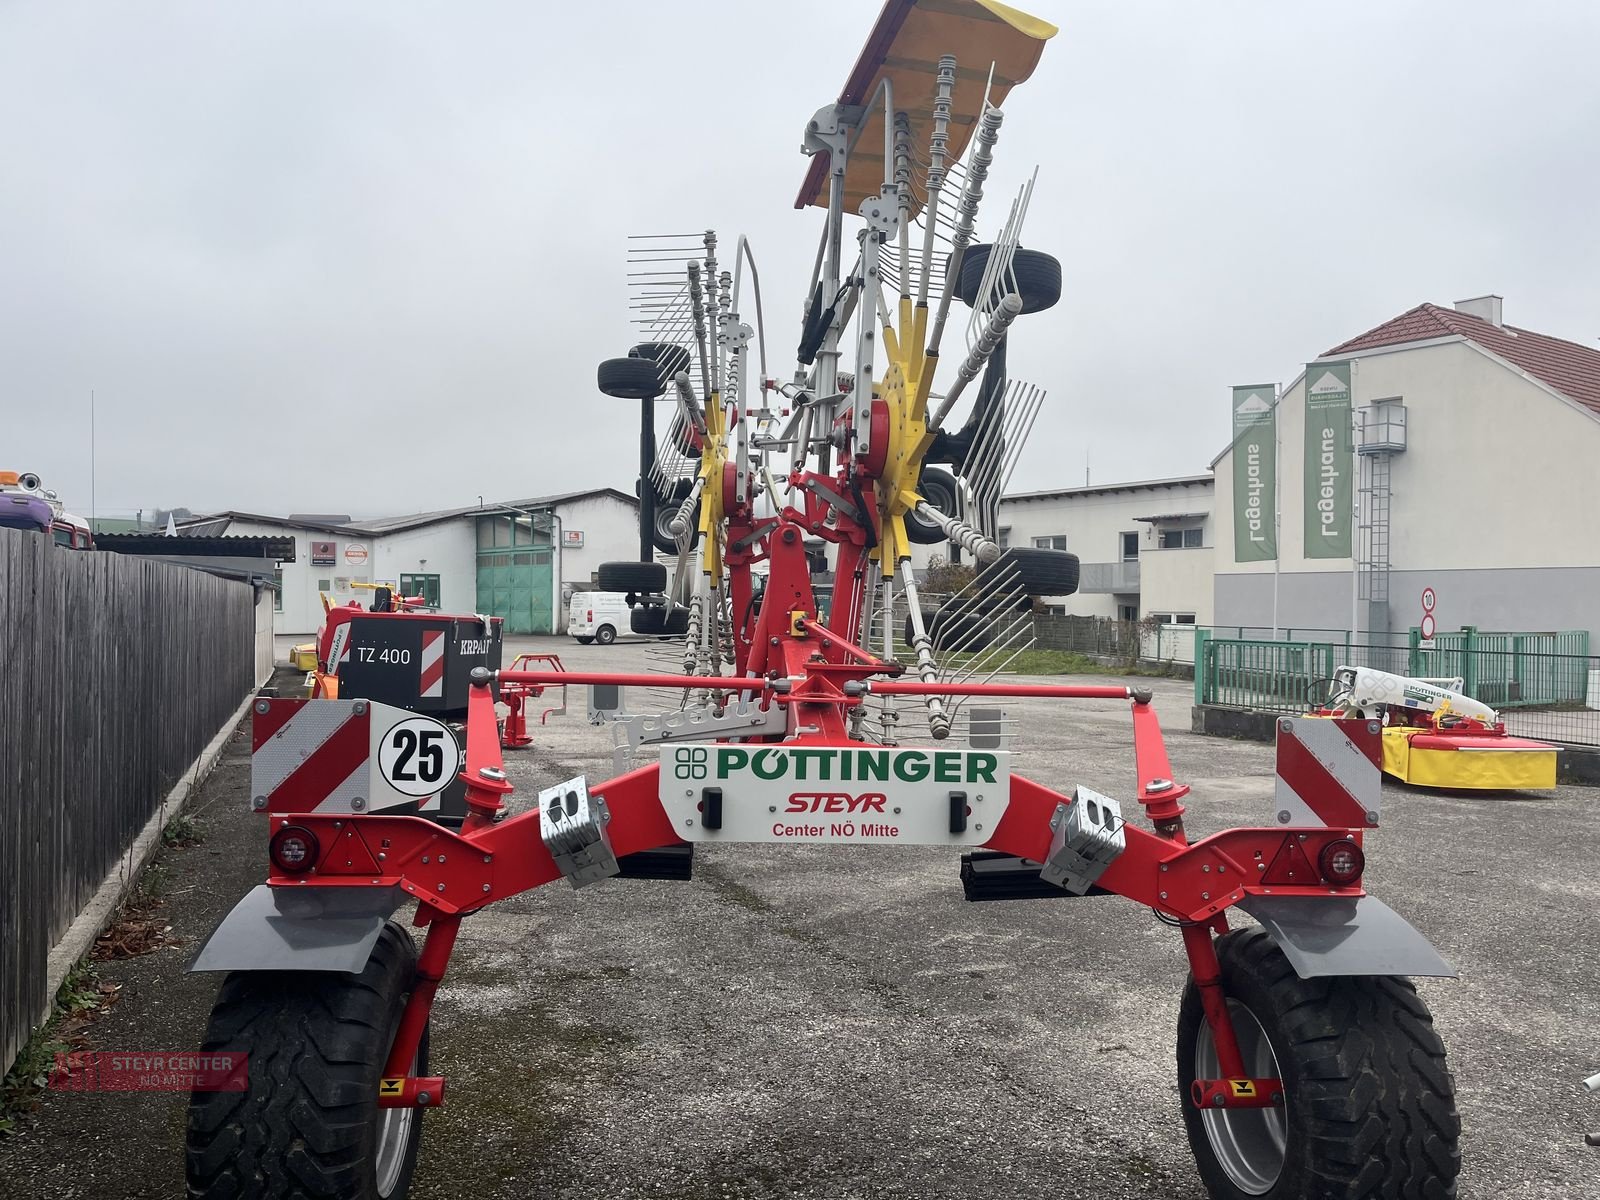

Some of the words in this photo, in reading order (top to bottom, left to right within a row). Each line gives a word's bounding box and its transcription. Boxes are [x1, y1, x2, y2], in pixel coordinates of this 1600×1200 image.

[357, 647, 375, 663] TZ
[379, 648, 411, 665] 400
[391, 729, 445, 783] 25
[716, 747, 998, 784] PÖTTINGER
[784, 792, 888, 814] STEYR
[772, 823, 826, 838] Center
[830, 819, 855, 838] NÖ
[860, 823, 899, 838] Mitte
